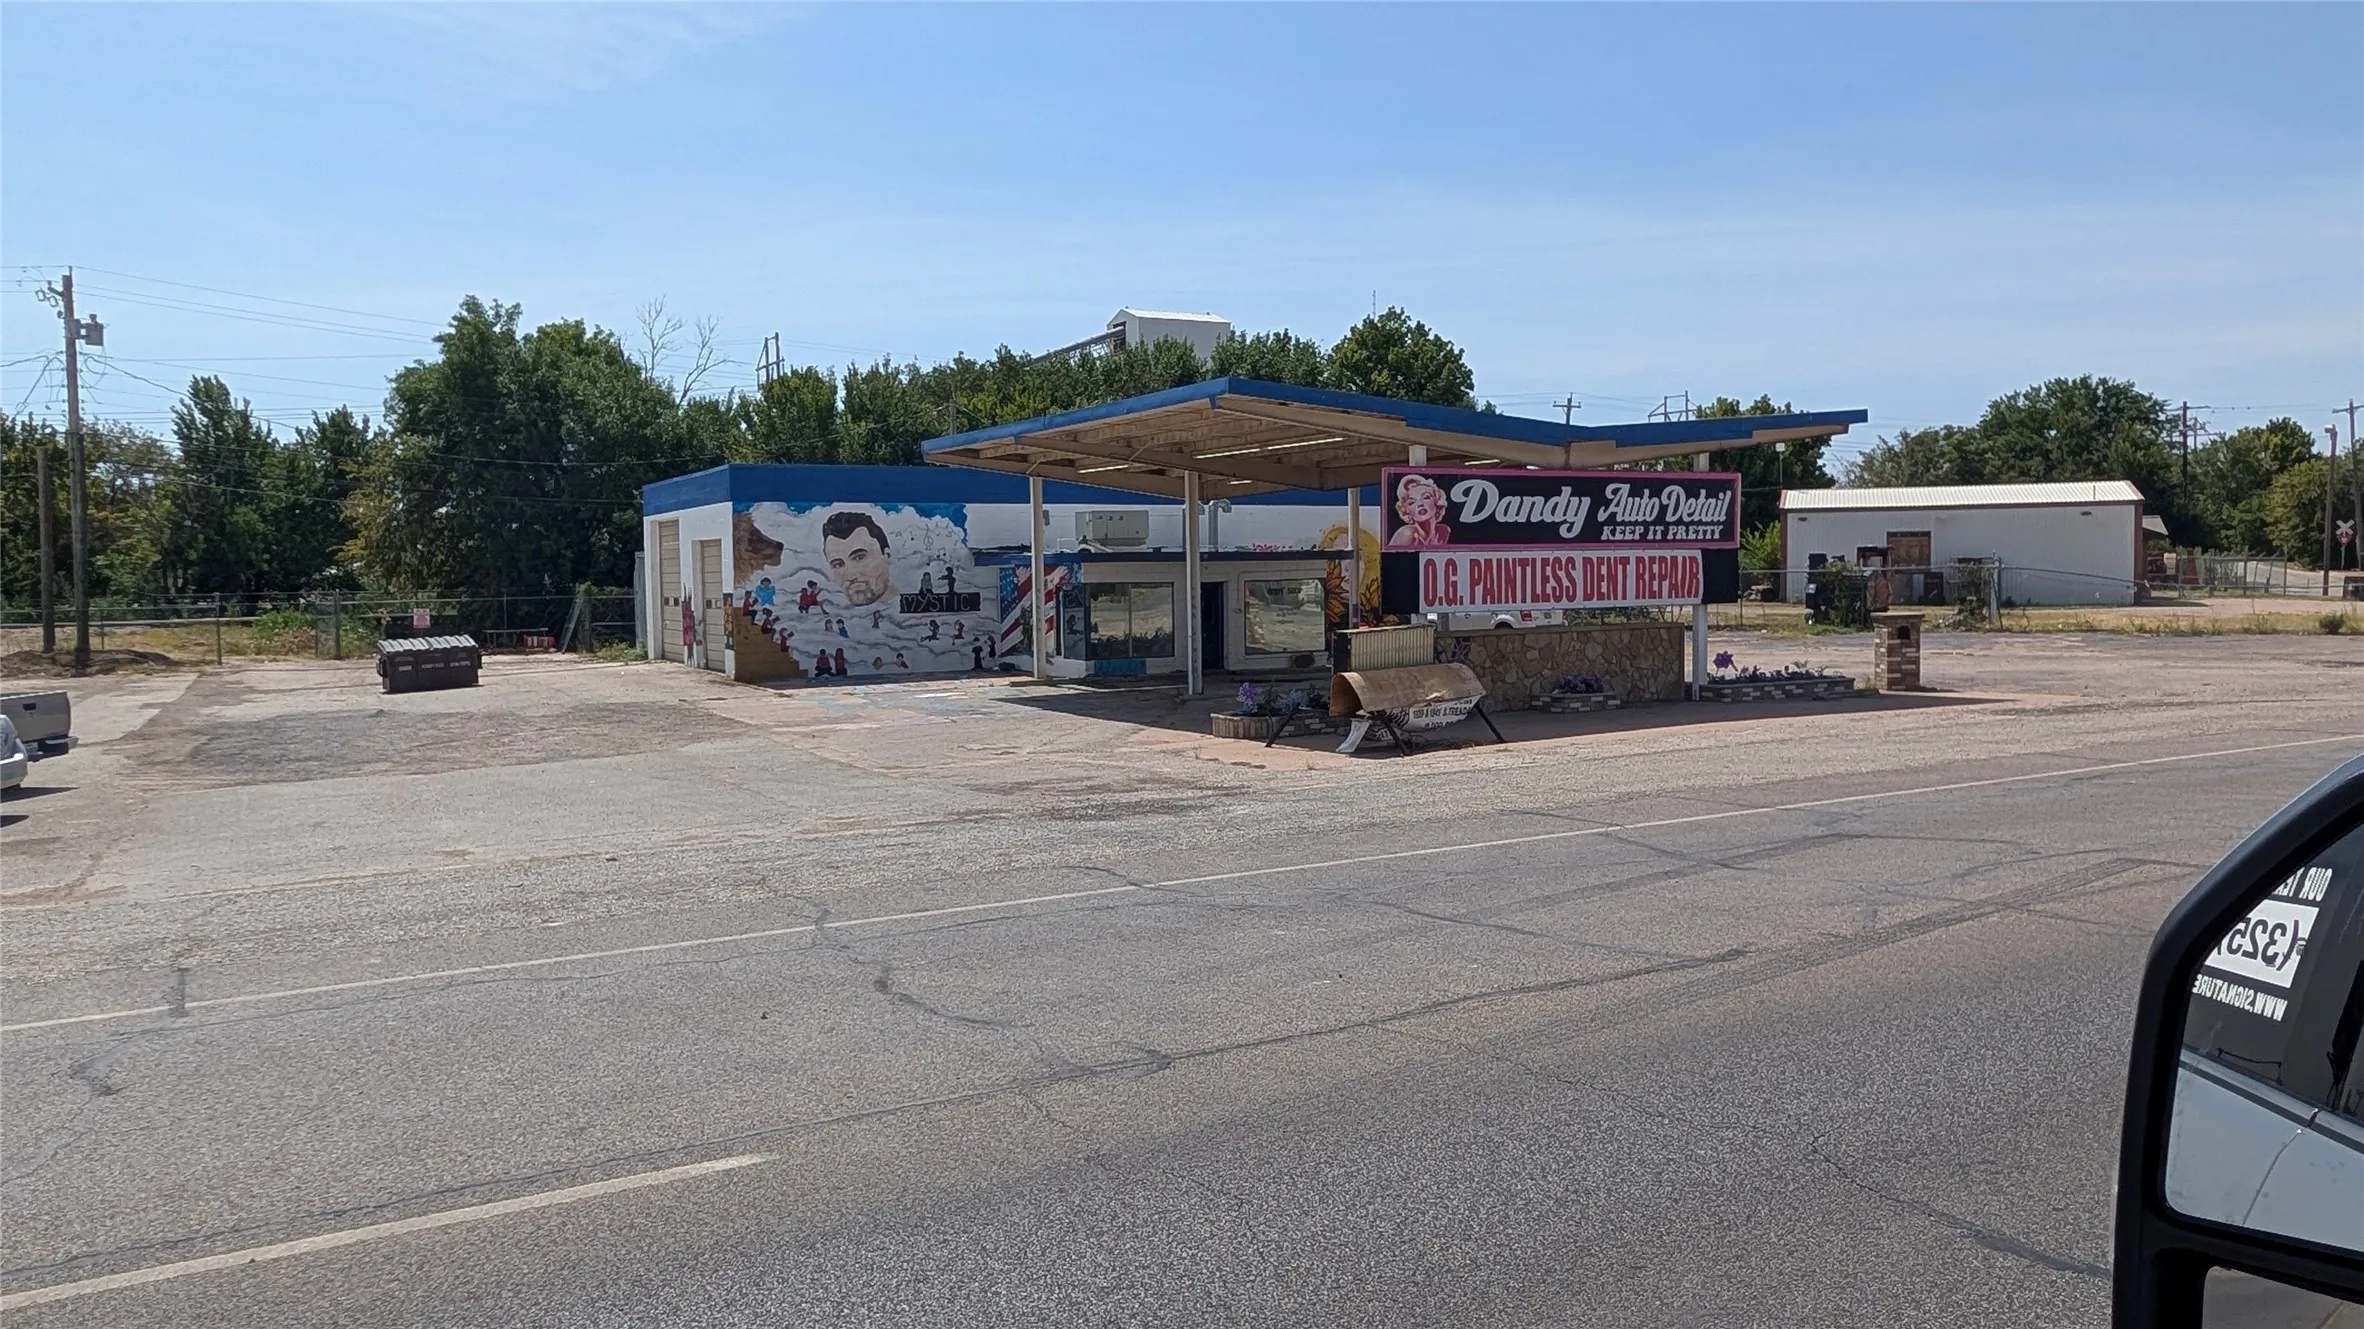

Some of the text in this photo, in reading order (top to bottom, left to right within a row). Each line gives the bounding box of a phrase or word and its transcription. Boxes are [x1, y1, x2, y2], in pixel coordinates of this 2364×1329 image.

[1450, 479, 1731, 539] Dandy Auto Detail
[1601, 525, 1724, 541] KEEP IT PRETTY
[1423, 554, 1700, 607] O.G. PAINTLESS DENT REPAIR
[902, 593, 970, 612] MYSTIC
